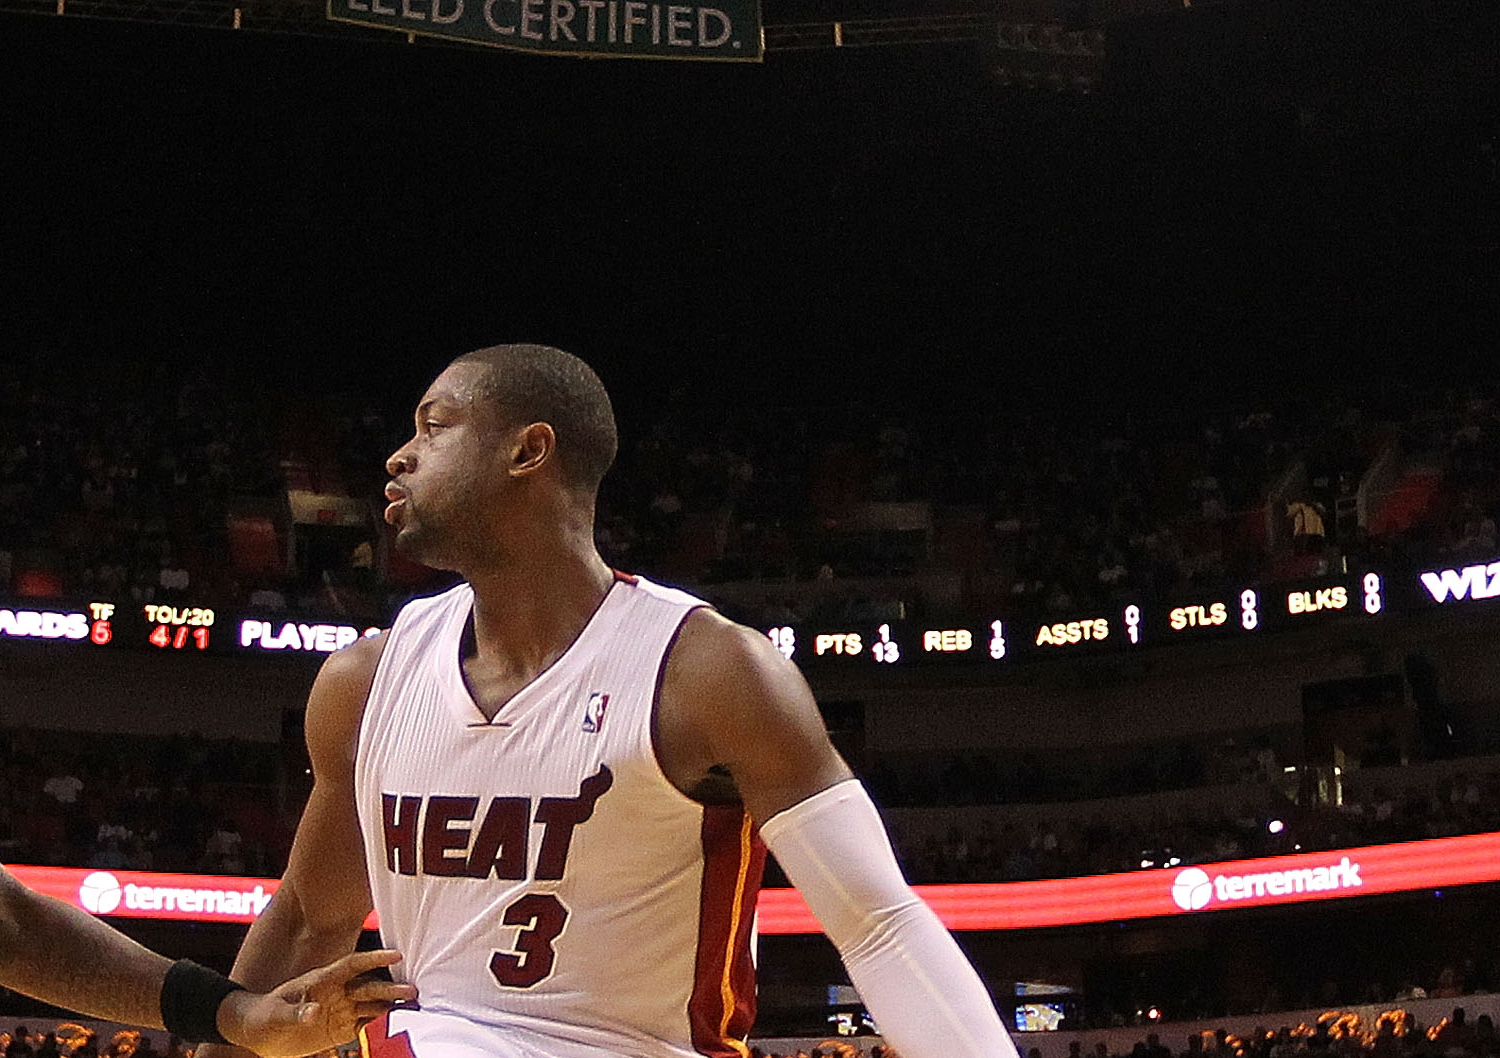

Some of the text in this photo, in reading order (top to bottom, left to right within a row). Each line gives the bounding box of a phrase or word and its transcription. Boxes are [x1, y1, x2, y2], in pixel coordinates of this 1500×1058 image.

[484, 0, 743, 49] CERTIFIED.
[89, 603, 115, 620] TF
[1287, 586, 1348, 615] BLKS
[1169, 602, 1228, 631] STLS
[239, 620, 358, 652] PLAYER
[814, 633, 863, 656] PTS
[922, 629, 973, 652] REB
[1035, 618, 1109, 646] ASSTS
[380, 763, 614, 882] HEAT
[1213, 856, 1363, 902] terremark
[123, 883, 272, 917] terremark
[487, 891, 573, 990] 3
